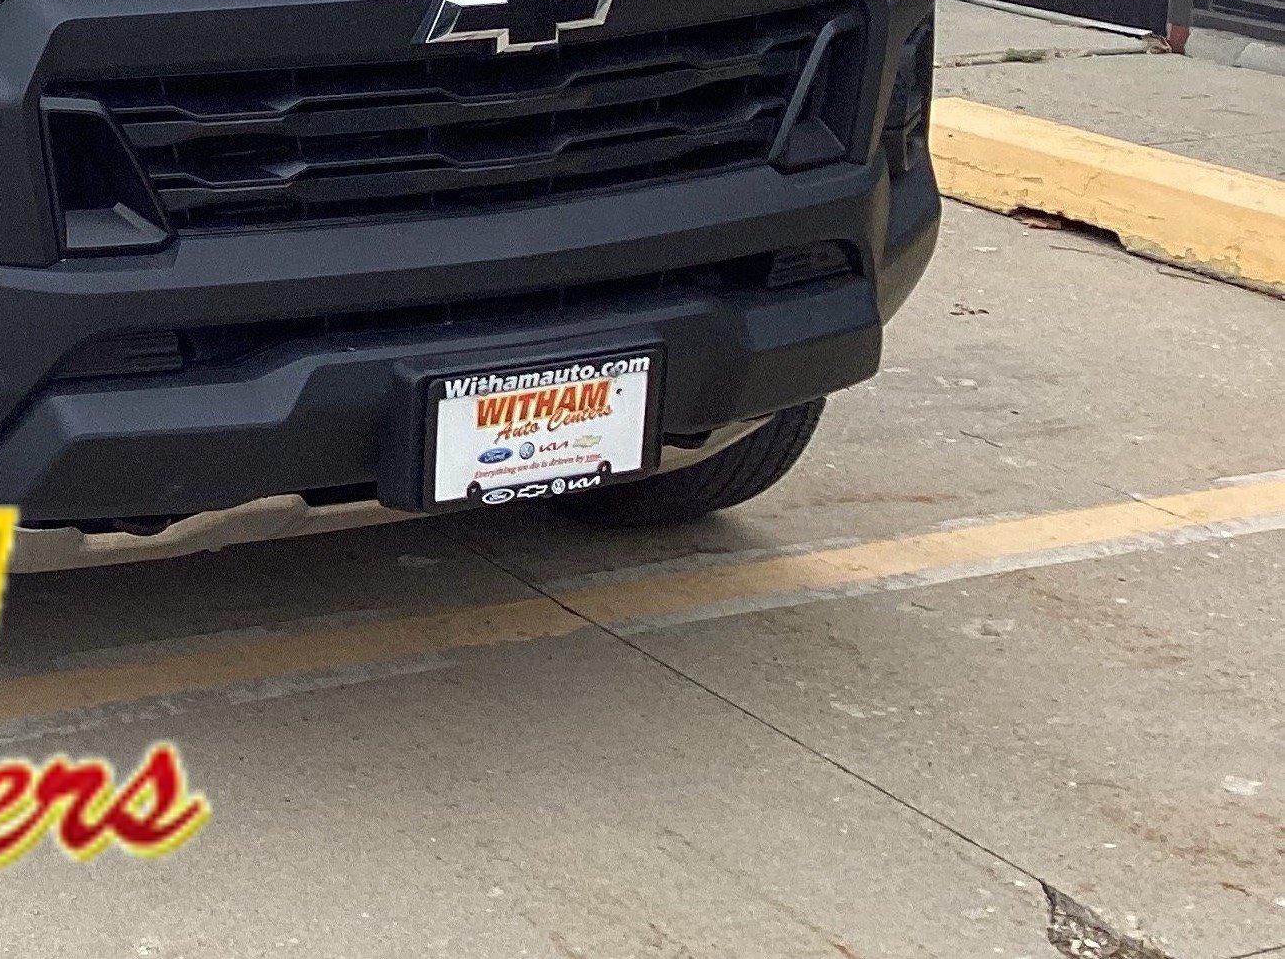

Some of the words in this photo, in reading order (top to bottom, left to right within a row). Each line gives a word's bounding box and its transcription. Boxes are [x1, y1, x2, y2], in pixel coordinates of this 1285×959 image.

[444, 356, 650, 400] Withamauto.com
[476, 379, 612, 428] WITHAM
[494, 420, 539, 445] Auto
[547, 404, 613, 432] Centers
